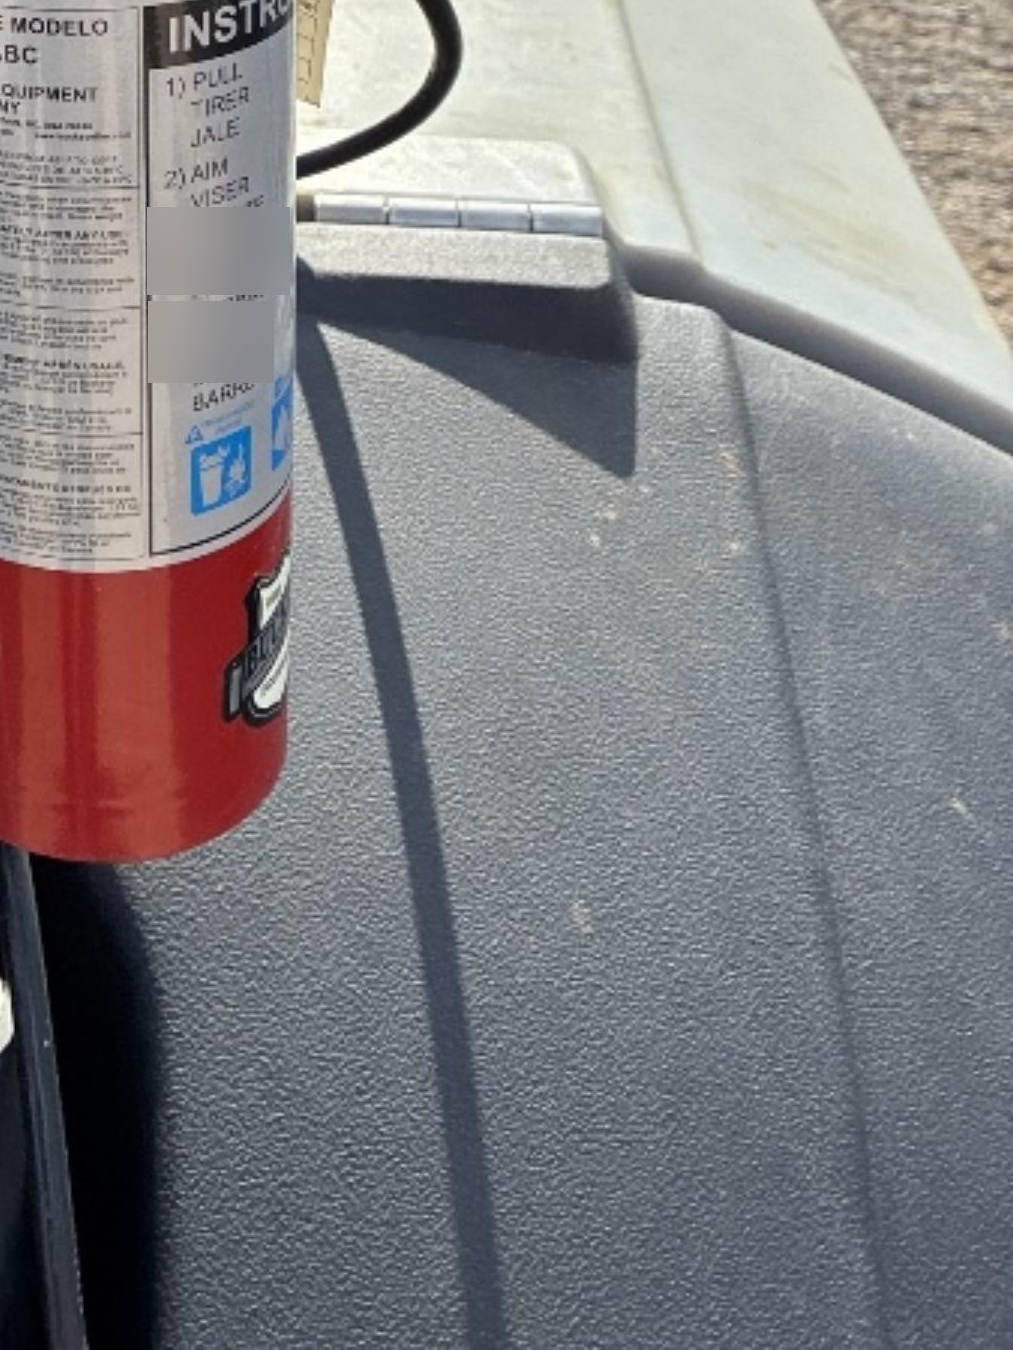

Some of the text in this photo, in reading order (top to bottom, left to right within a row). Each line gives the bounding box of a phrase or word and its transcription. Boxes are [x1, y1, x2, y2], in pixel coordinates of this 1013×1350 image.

[10, 16, 109, 38] MODELO
[166, 61, 244, 100] 1) PULL
[189, 85, 250, 118] TIRER
[189, 116, 240, 148] JALE
[164, 155, 229, 191] 2) AIM
